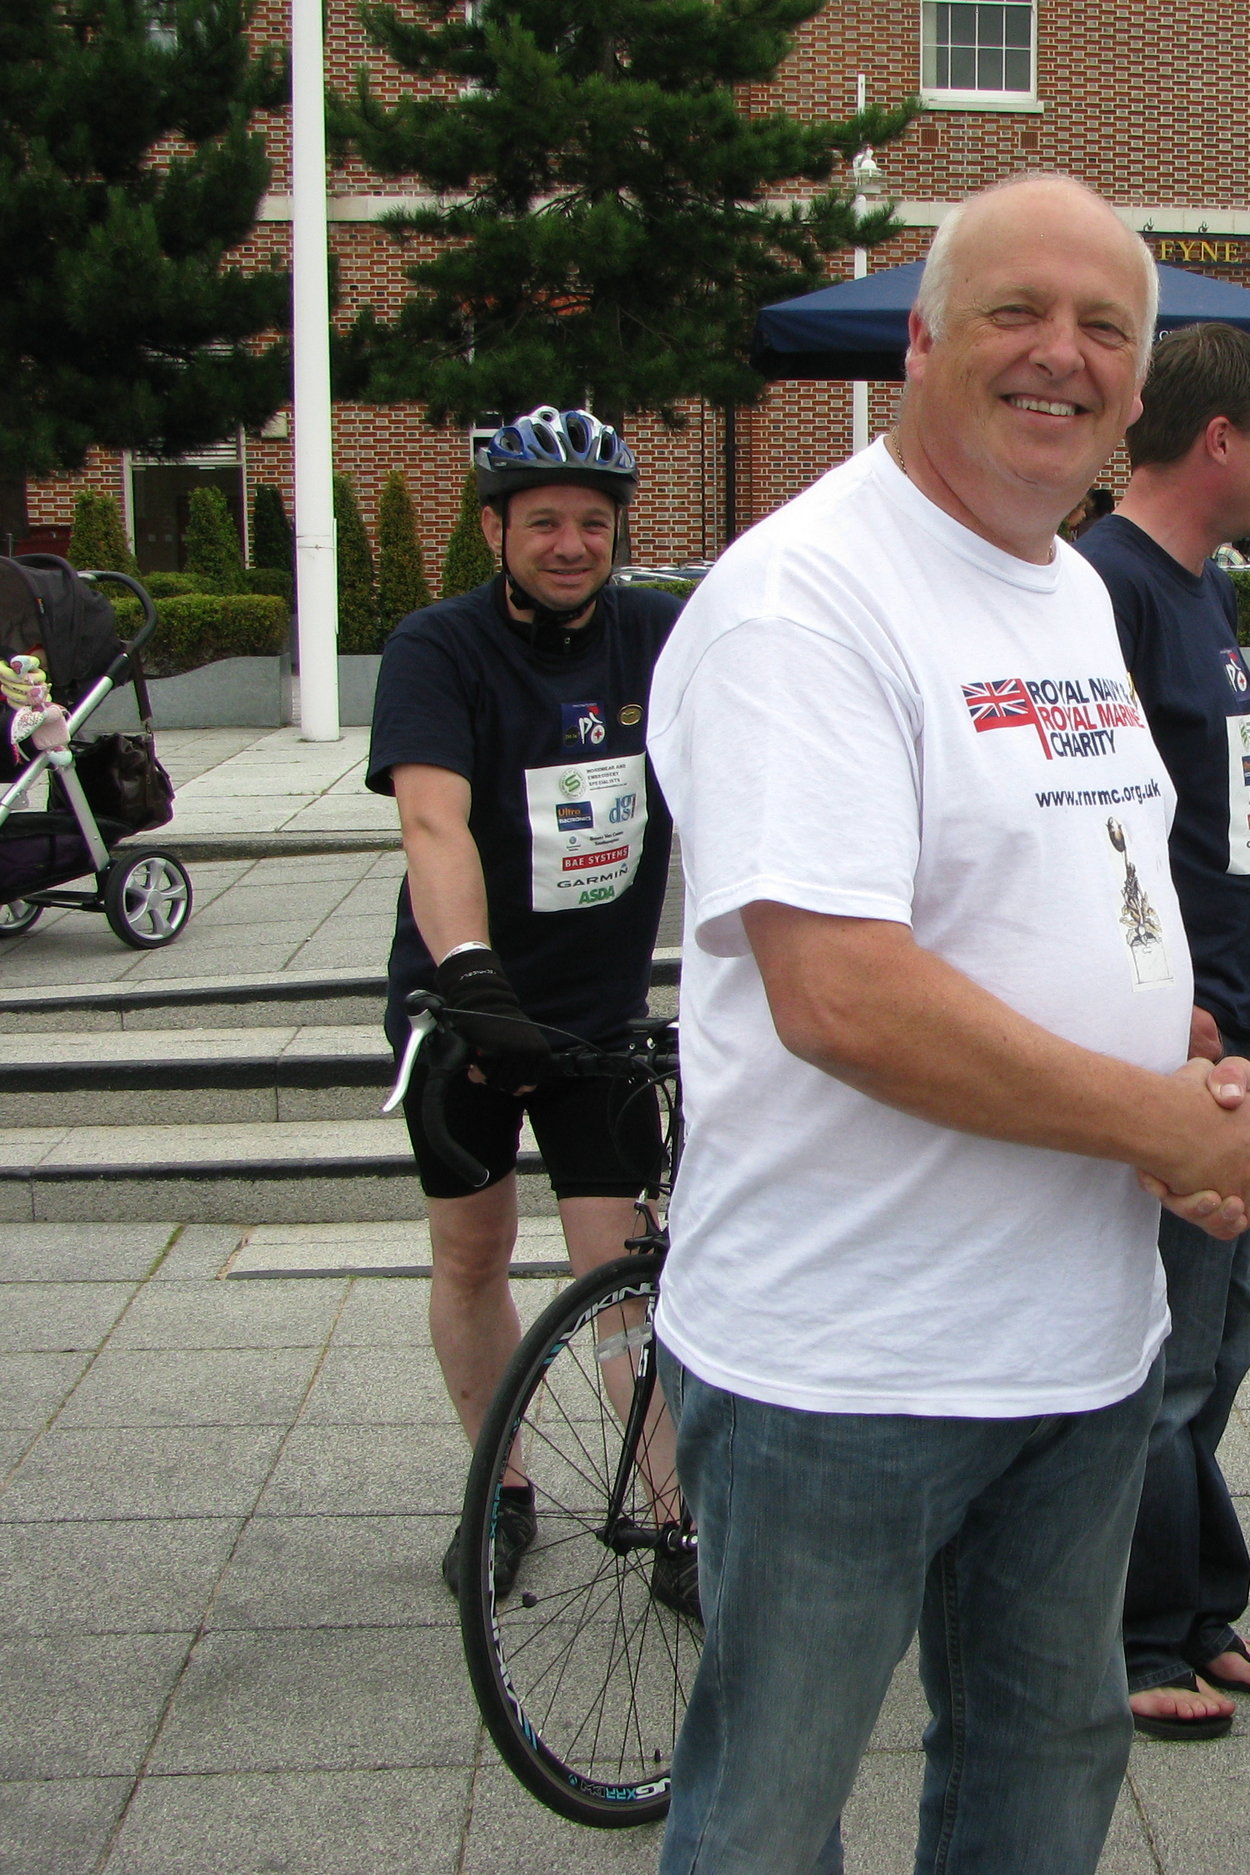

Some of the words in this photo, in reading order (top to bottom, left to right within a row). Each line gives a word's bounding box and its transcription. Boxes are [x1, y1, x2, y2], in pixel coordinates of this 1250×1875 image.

[1159, 240, 1240, 263] FYNE
[1025, 679, 1090, 706] ROYAL
[1090, 677, 1124, 704] NAVY
[1038, 705, 1099, 732] ROYAL
[1050, 729, 1117, 758] CHARITY
[1035, 778, 1161, 808] www.rnrmc.org.uk
[565, 858, 585, 868] BAE
[588, 848, 628, 865] SYSTEMS
[557, 867, 628, 888] GARMIN
[578, 885, 616, 905] ASDA
